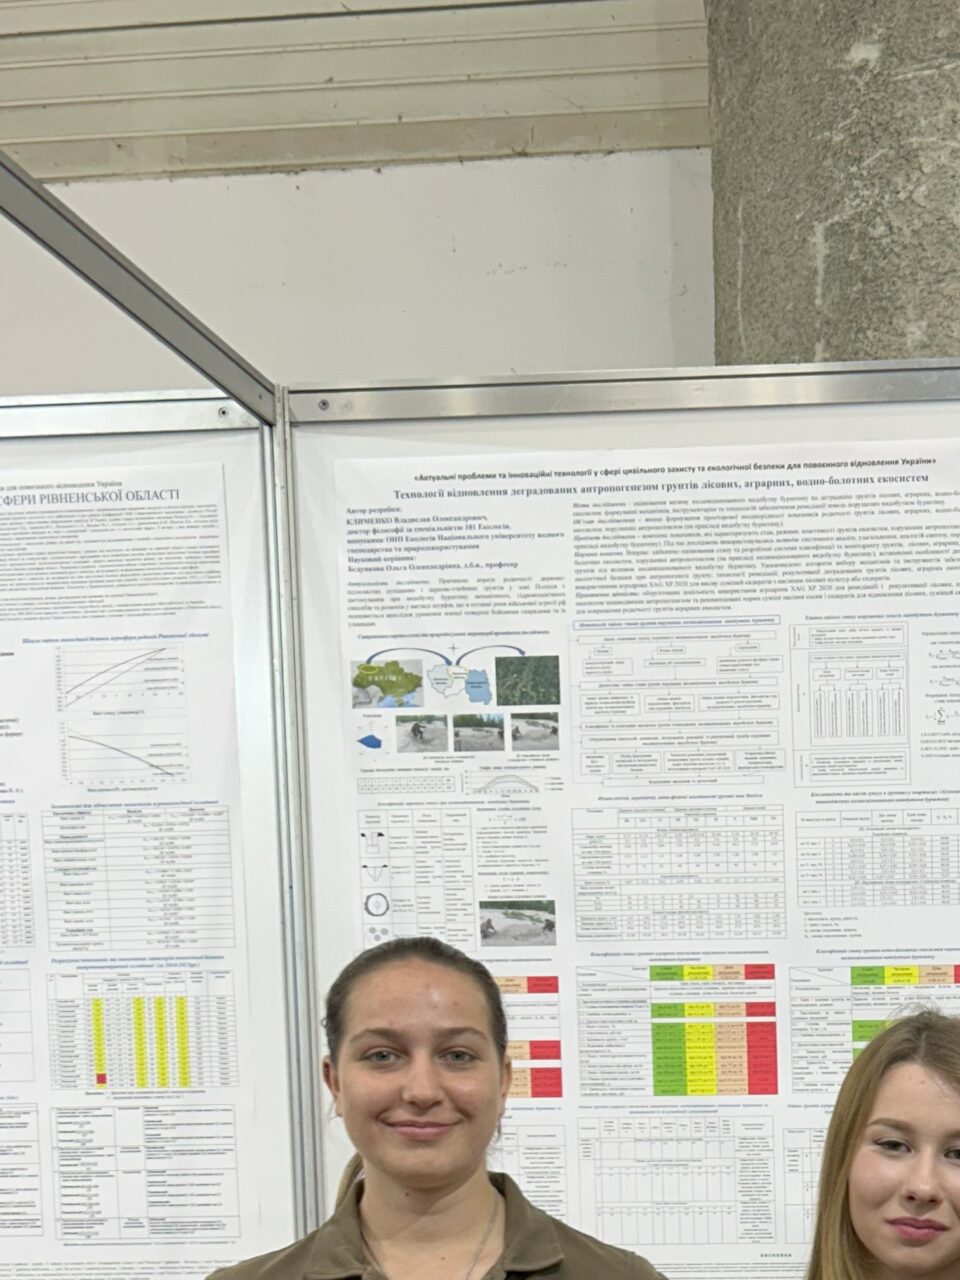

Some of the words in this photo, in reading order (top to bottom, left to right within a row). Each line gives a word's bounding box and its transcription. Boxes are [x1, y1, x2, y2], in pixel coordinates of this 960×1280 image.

[0, 494, 36, 505] ФЕРИ
[39, 489, 122, 503] РІВНЕНСЬКОЇ
[125, 488, 179, 500] ОБЛАСТІ
